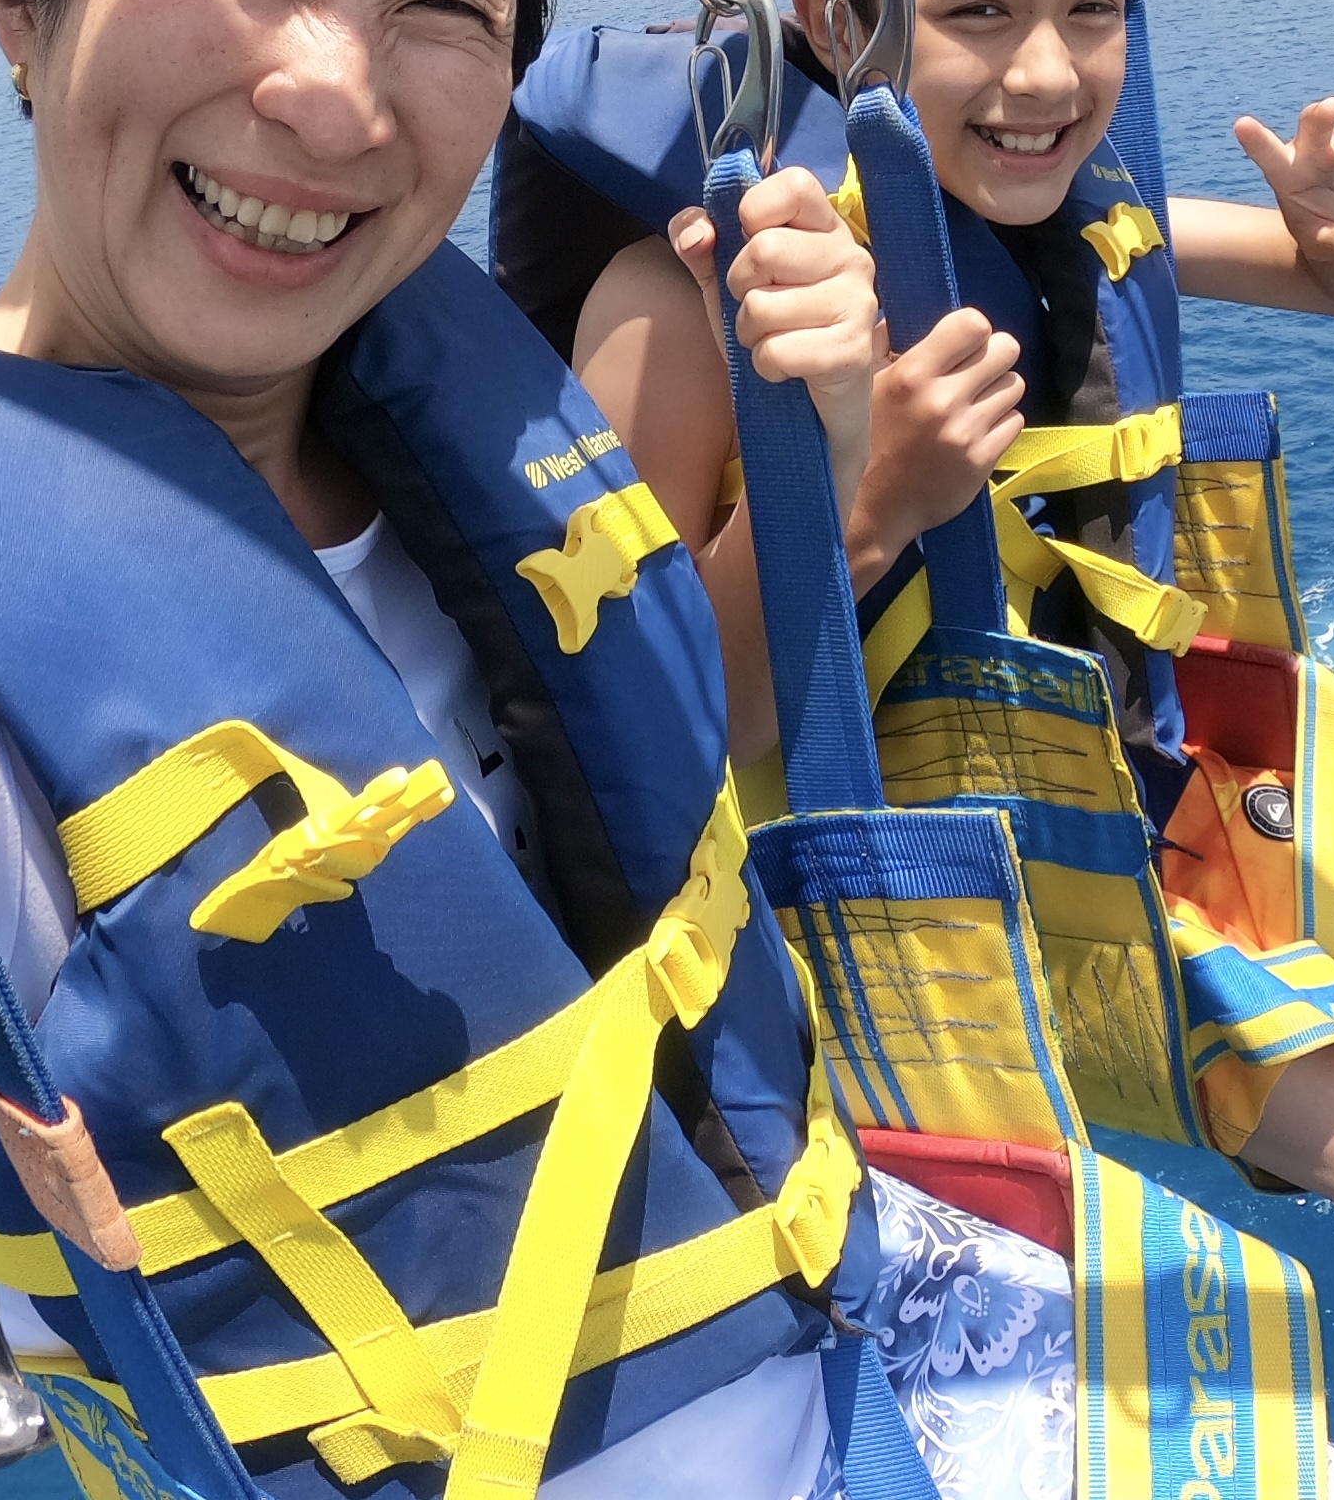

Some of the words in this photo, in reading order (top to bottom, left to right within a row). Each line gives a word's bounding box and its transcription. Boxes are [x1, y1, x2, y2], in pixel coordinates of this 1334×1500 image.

[540, 445, 586, 482] West
[575, 427, 623, 463] Marine
[1163, 1187, 1236, 1500] arasa
